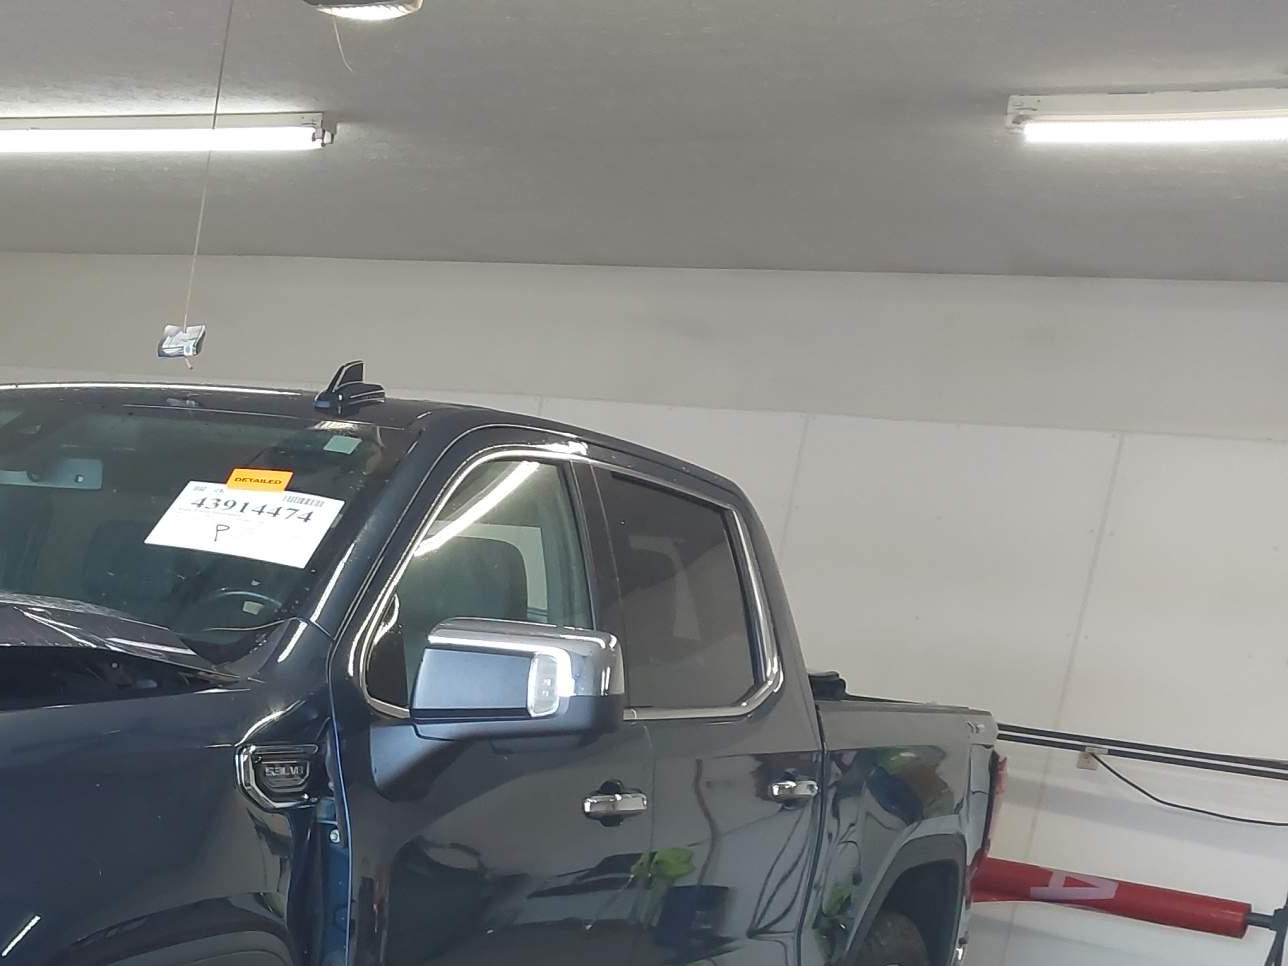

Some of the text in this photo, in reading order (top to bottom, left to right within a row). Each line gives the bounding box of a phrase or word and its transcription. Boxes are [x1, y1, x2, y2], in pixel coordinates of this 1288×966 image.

[234, 477, 282, 485] DETAILED
[191, 496, 314, 523] 43914474
[214, 524, 231, 542] P
